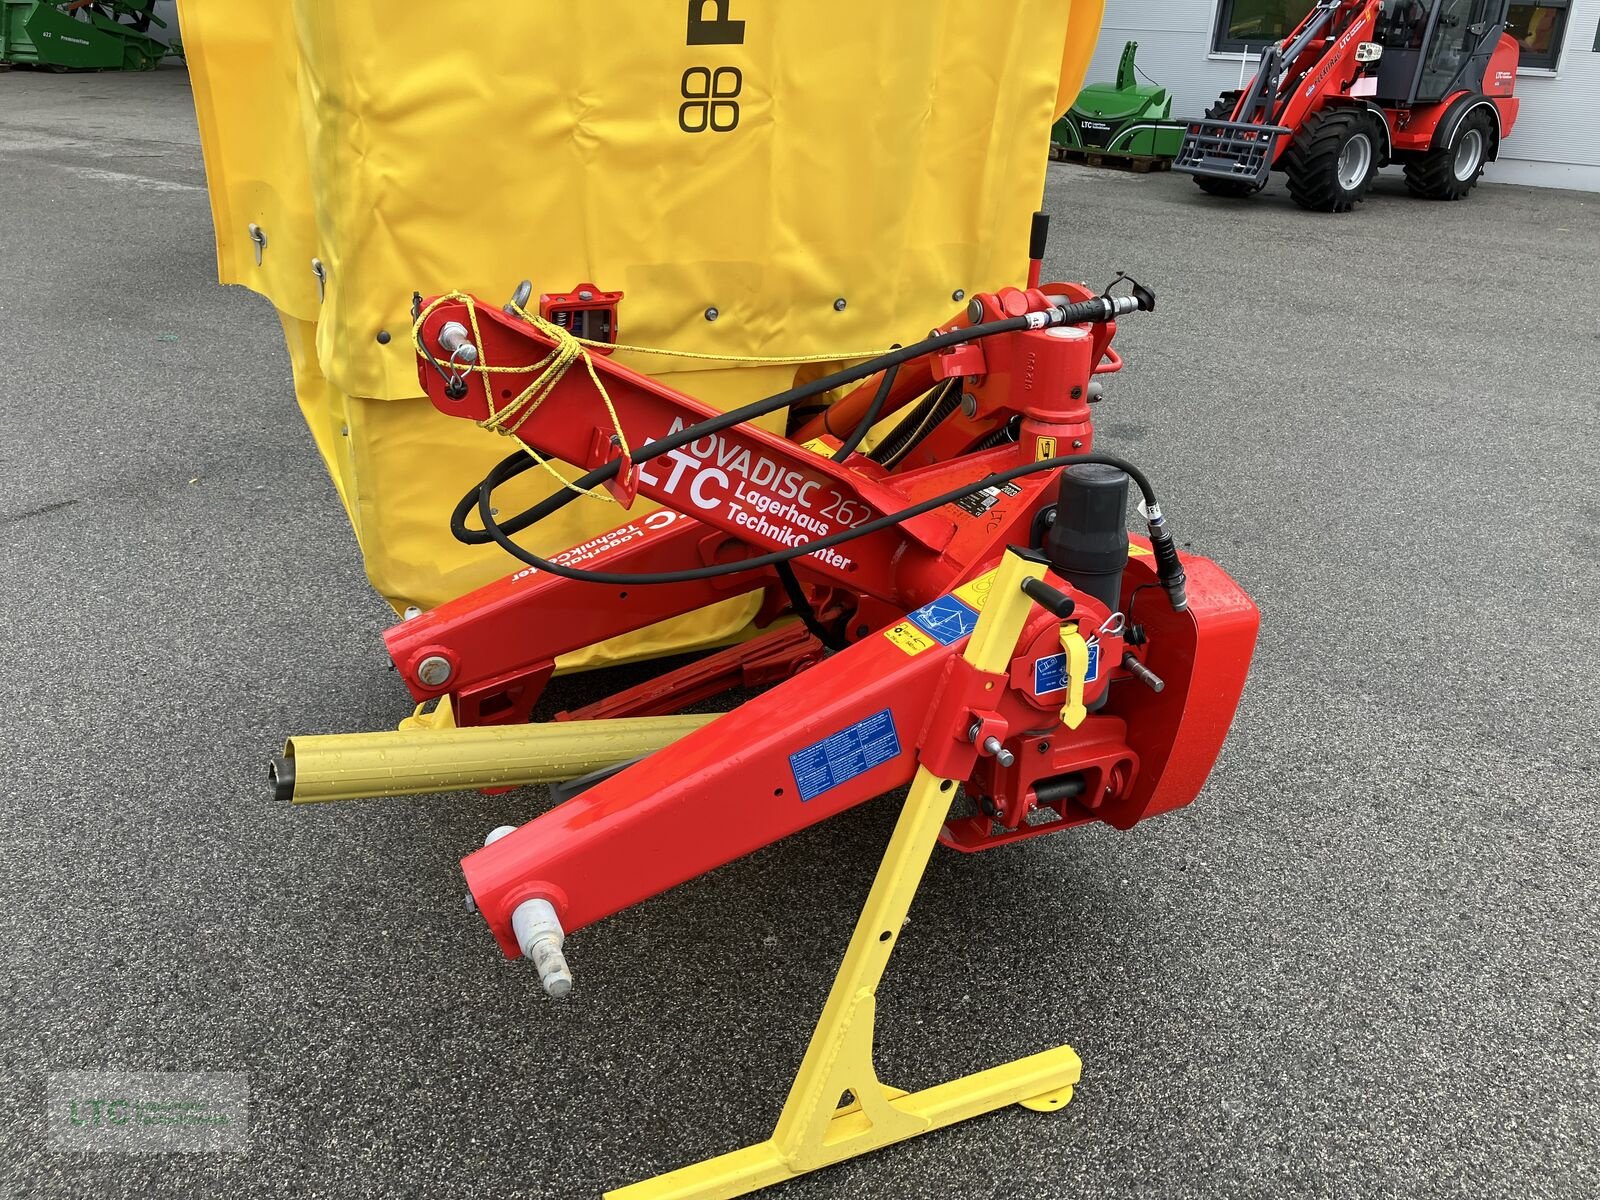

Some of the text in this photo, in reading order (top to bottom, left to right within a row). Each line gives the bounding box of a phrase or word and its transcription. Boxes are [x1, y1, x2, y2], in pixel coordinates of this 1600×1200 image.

[1081, 120, 1093, 129] LTC
[734, 480, 830, 537] Lagerhaus
[819, 489, 872, 529] 262
[727, 501, 852, 571] TechnikCnter
